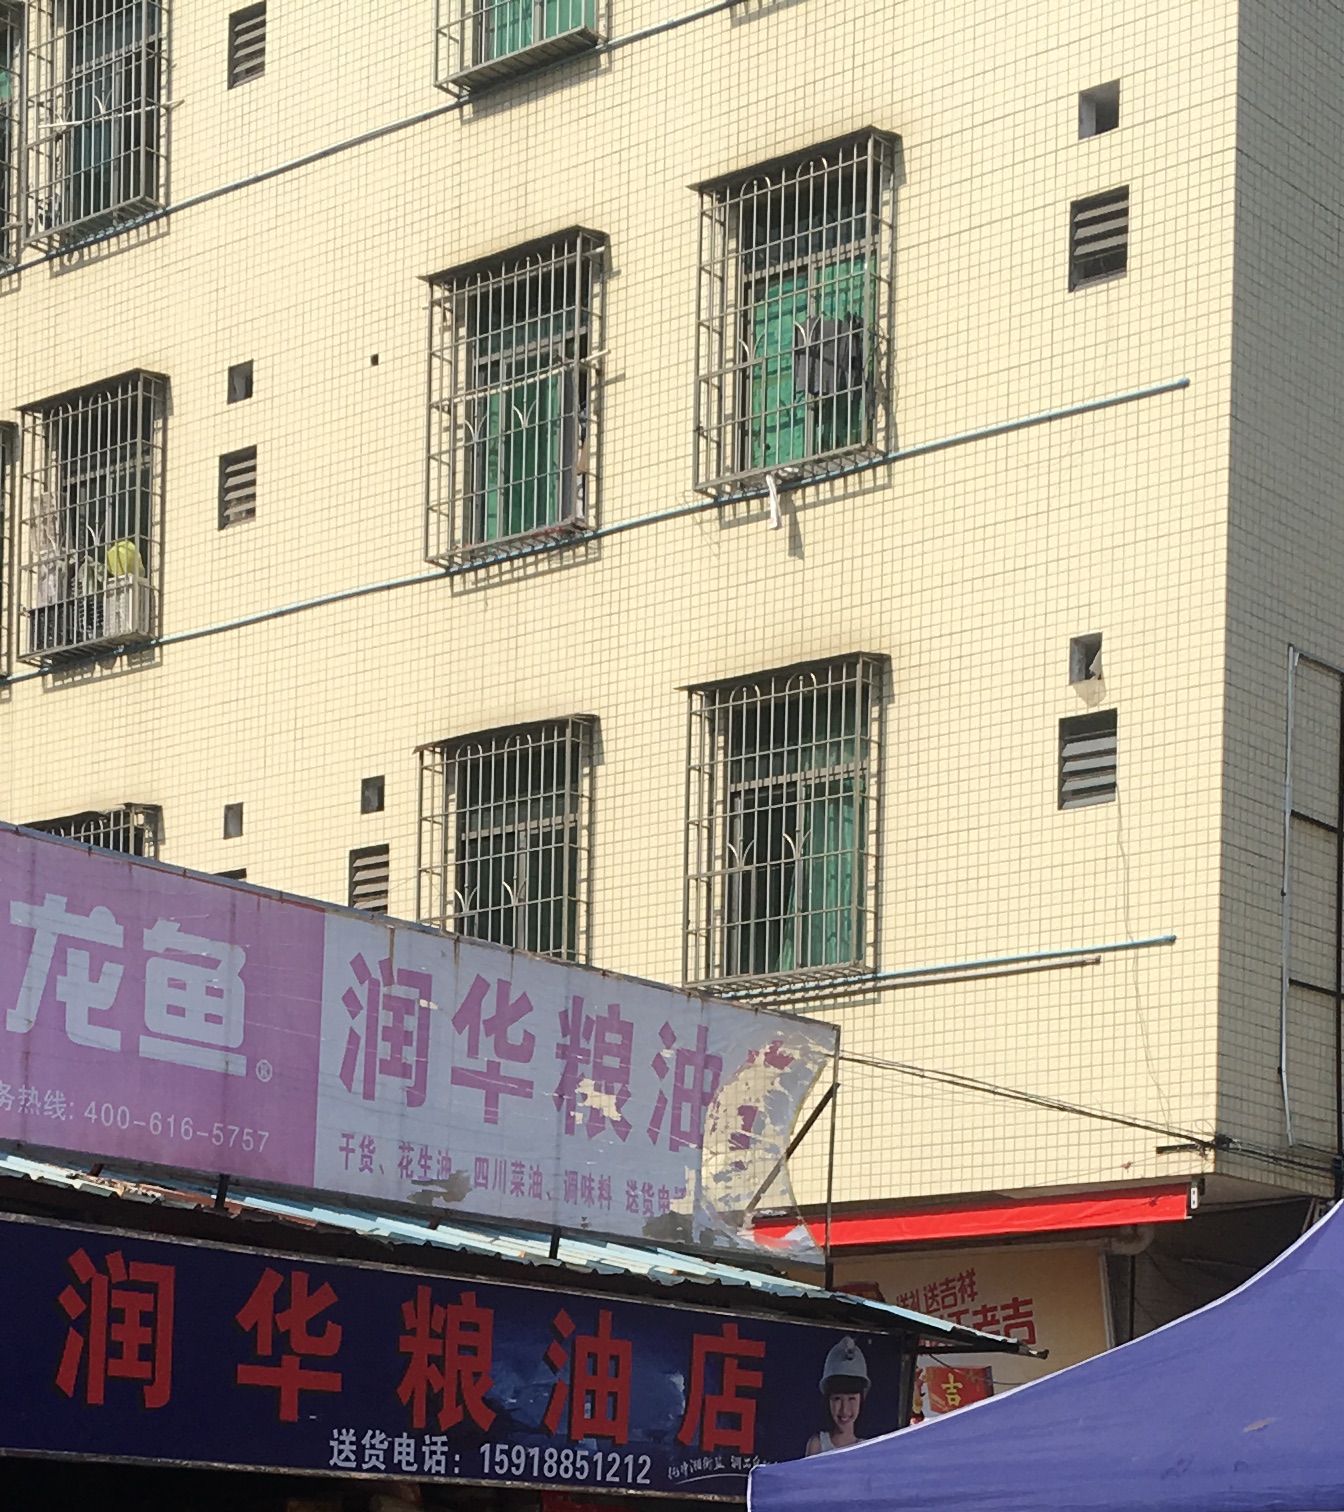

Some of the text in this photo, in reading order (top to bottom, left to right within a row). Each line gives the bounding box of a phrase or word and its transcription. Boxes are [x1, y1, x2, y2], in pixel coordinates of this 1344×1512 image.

[339, 952, 794, 1160] 润华粮油
[84, 1102, 270, 1154] 400-616-5757
[57, 1246, 767, 1454] 润华粮油店
[329, 1428, 651, 1485] 送货电话： 15918851212
